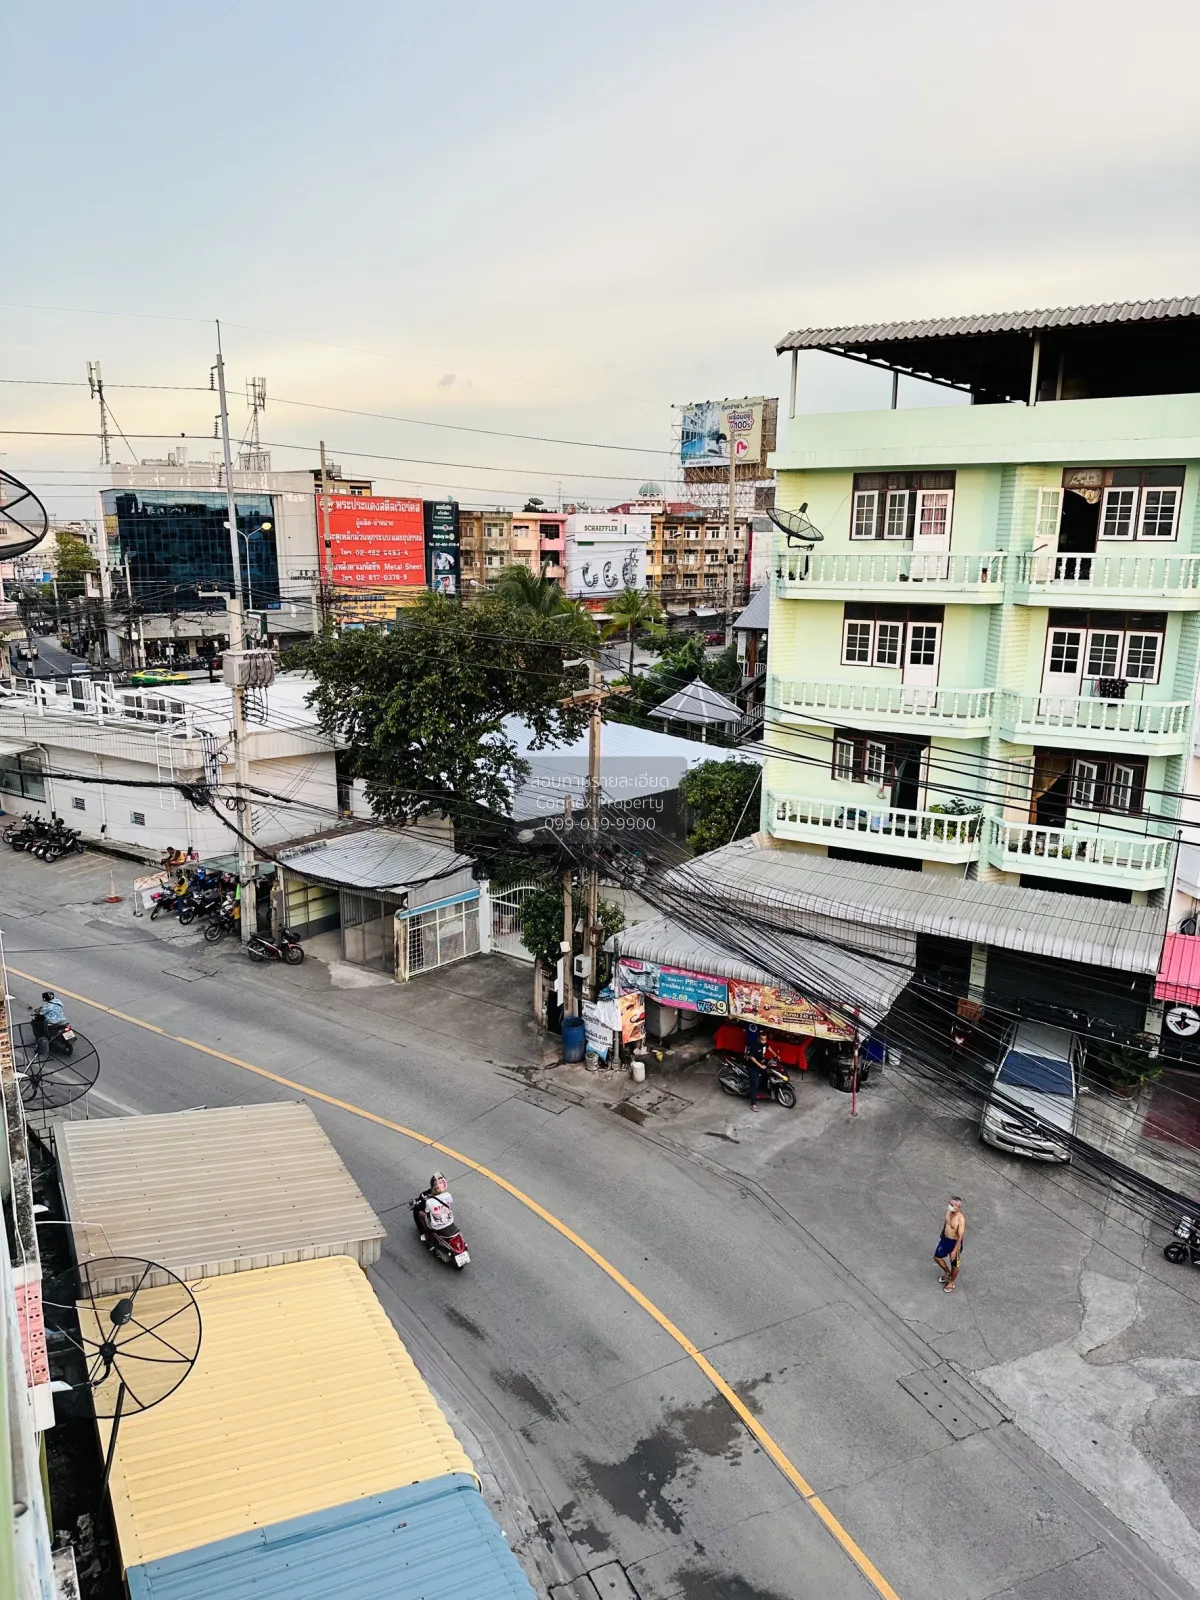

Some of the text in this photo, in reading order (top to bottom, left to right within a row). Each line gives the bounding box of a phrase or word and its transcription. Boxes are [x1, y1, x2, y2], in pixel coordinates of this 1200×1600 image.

[384, 563, 403, 571] Metal
[405, 563, 423, 571] Sheet
[703, 983, 719, 991] SALE
